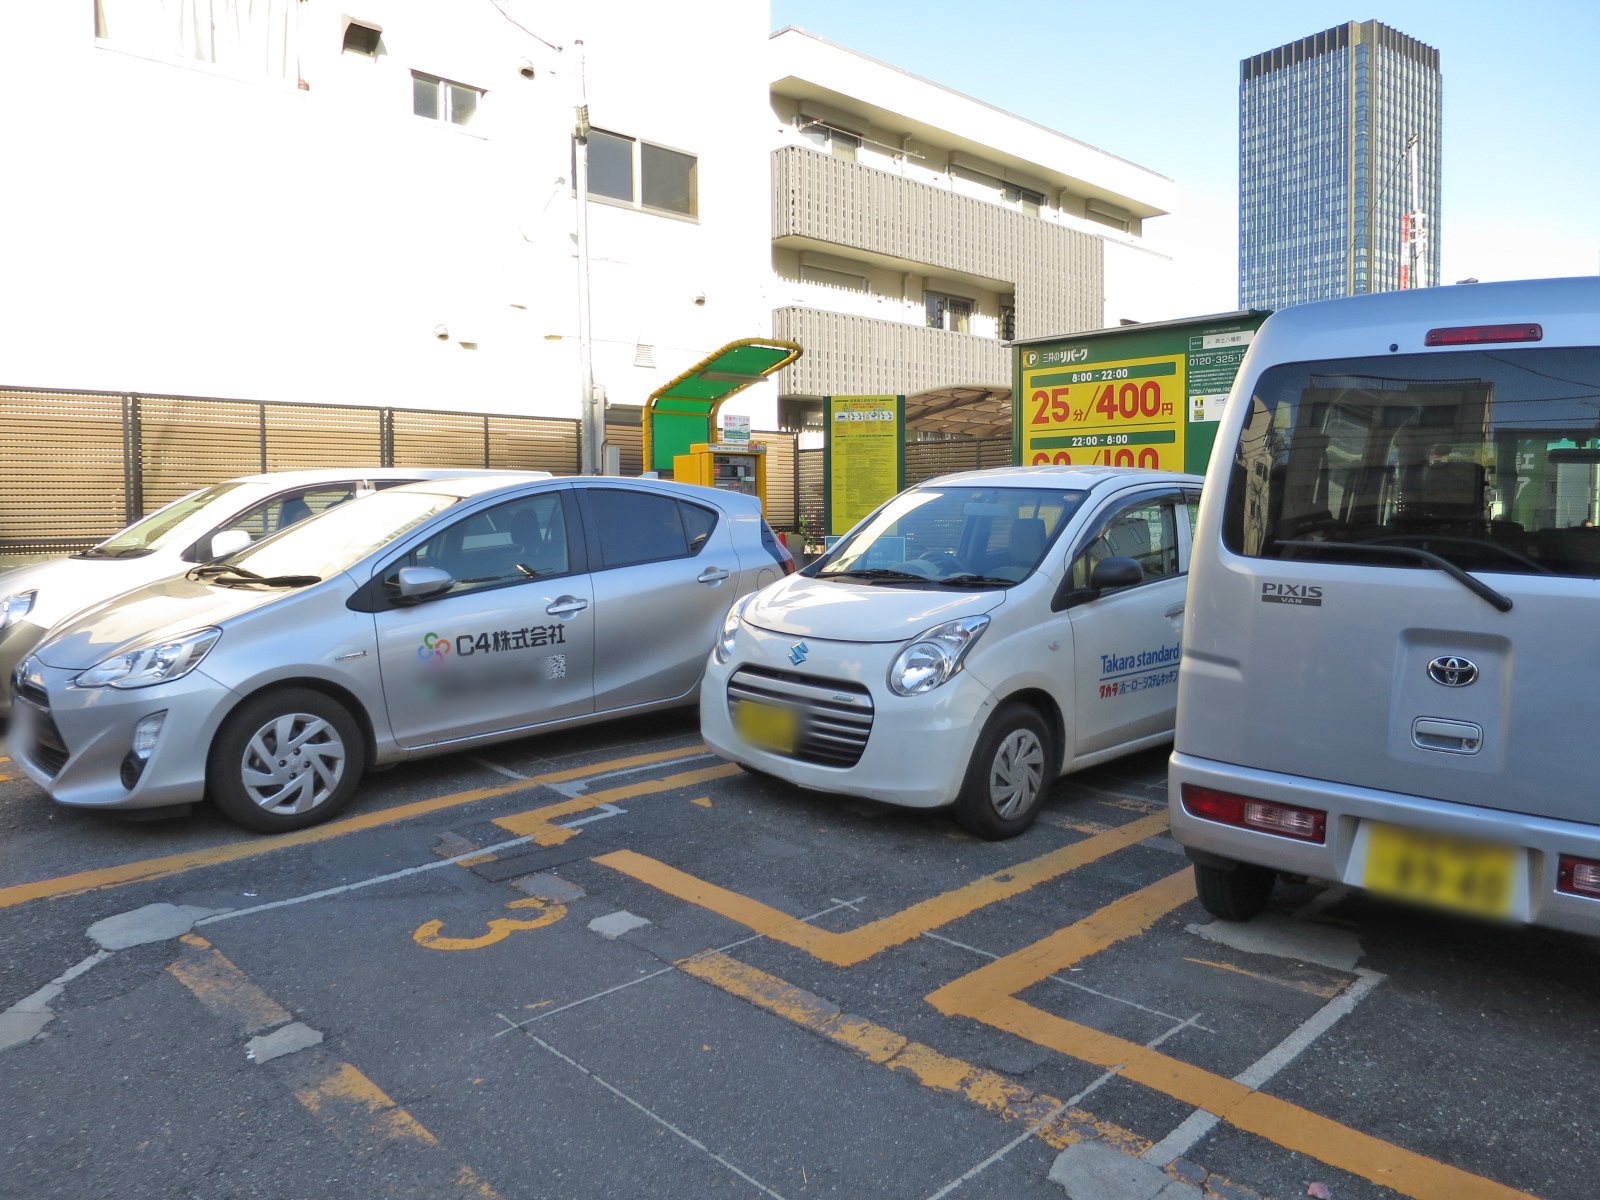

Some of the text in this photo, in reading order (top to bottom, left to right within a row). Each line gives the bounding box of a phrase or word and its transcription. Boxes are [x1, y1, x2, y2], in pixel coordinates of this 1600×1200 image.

[1042, 349, 1089, 363] 三井のリパーク
[1071, 372, 1092, 383] 8:00
[1101, 368, 1128, 381] 22:00
[1071, 436, 1098, 447] 22:00
[1106, 434, 1128, 445] 8:00
[1261, 582, 1323, 598] PIXIS
[455, 623, 566, 657] C4株式会社
[1100, 642, 1180, 674] Takara standard
[412, 897, 568, 951] 3
